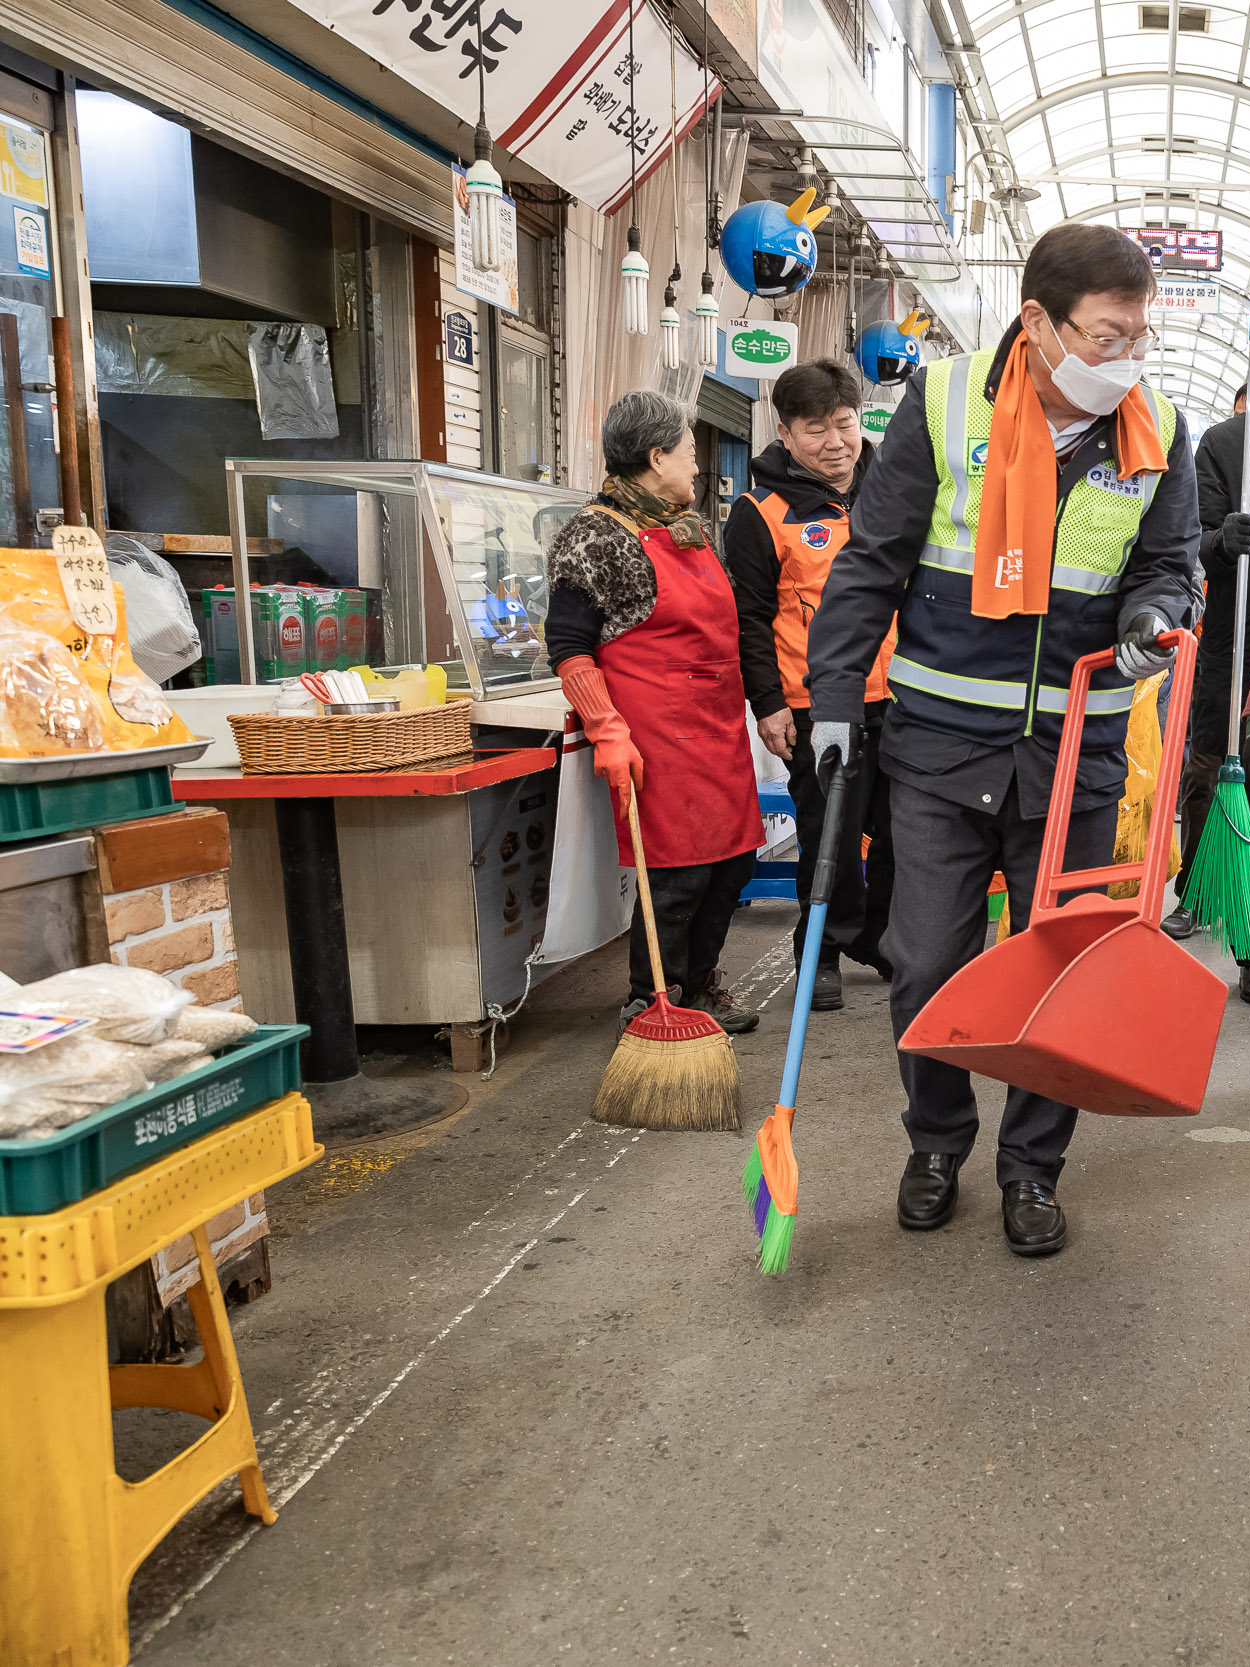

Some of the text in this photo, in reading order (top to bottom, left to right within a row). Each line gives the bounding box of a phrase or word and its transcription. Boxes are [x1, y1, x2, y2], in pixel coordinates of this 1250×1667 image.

[614, 52, 643, 85] 찹쌀
[730, 319, 749, 328] 104호
[453, 335, 467, 358] 28
[733, 337, 789, 357] 손수만두
[1103, 480, 1140, 496] 광진구청장
[809, 528, 831, 542] 119
